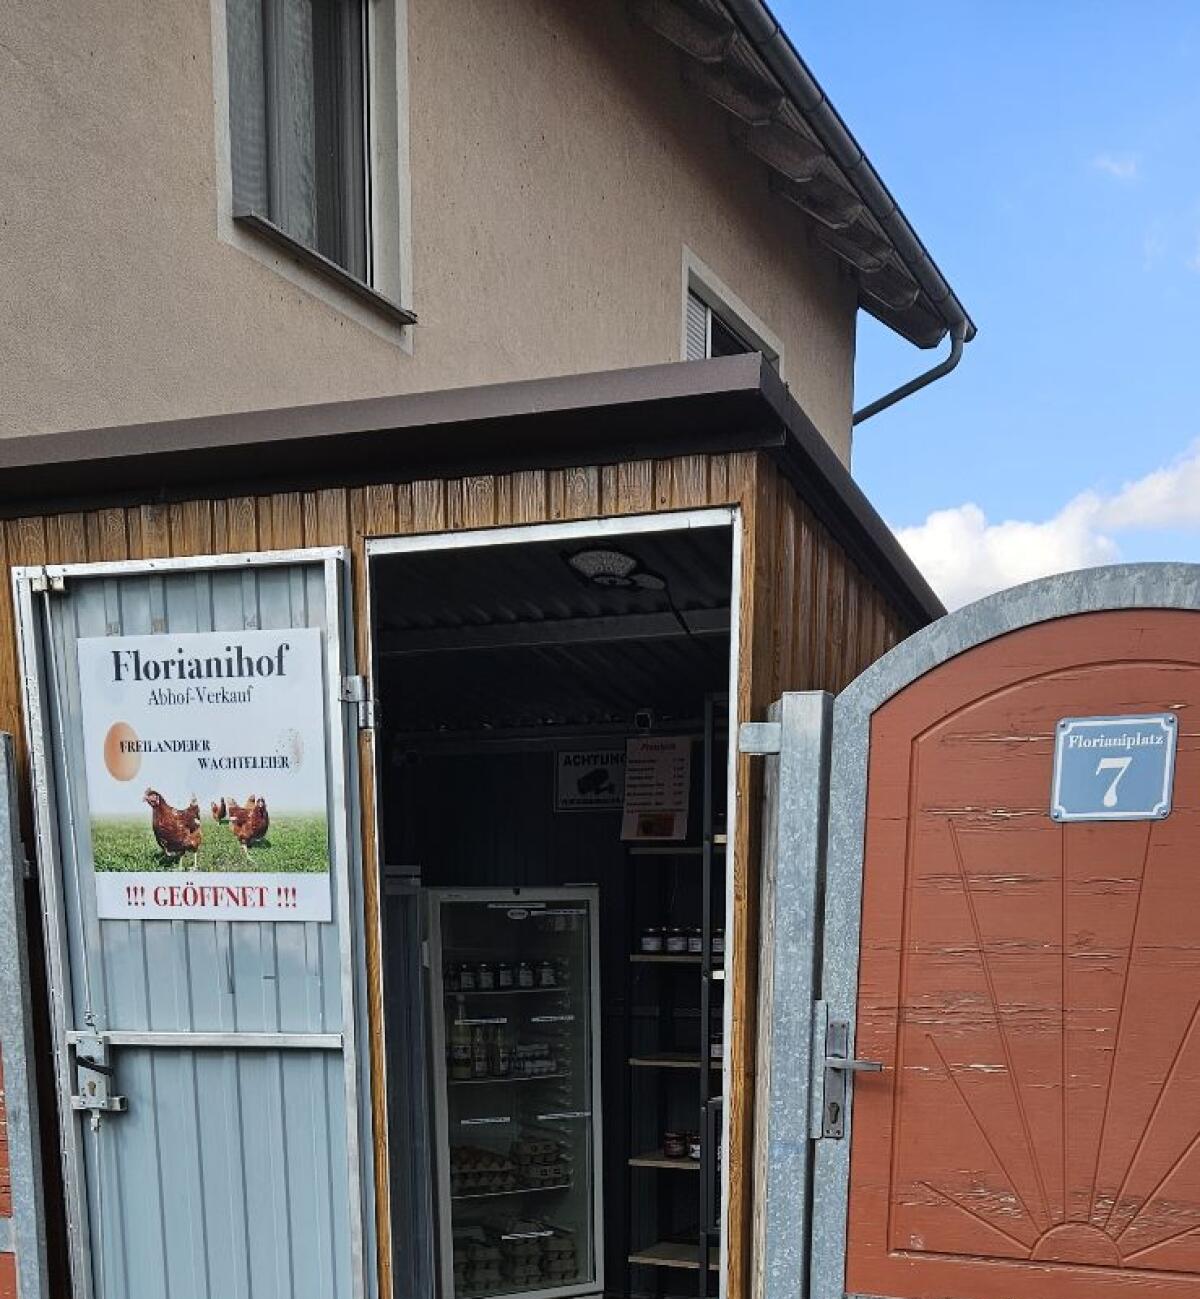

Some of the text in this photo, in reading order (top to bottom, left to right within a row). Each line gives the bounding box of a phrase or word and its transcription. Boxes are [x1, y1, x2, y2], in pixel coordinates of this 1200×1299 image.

[111, 642, 290, 683] Florianihof
[147, 685, 254, 706] Abhof-Verkauf
[119, 739, 211, 753] FREILANDEIER
[1068, 731, 1164, 749] Florianiplatz
[197, 756, 290, 769] WACHTELEIER
[1095, 756, 1133, 807] 7
[126, 881, 298, 908] !!! GEÖFFNET !!!
